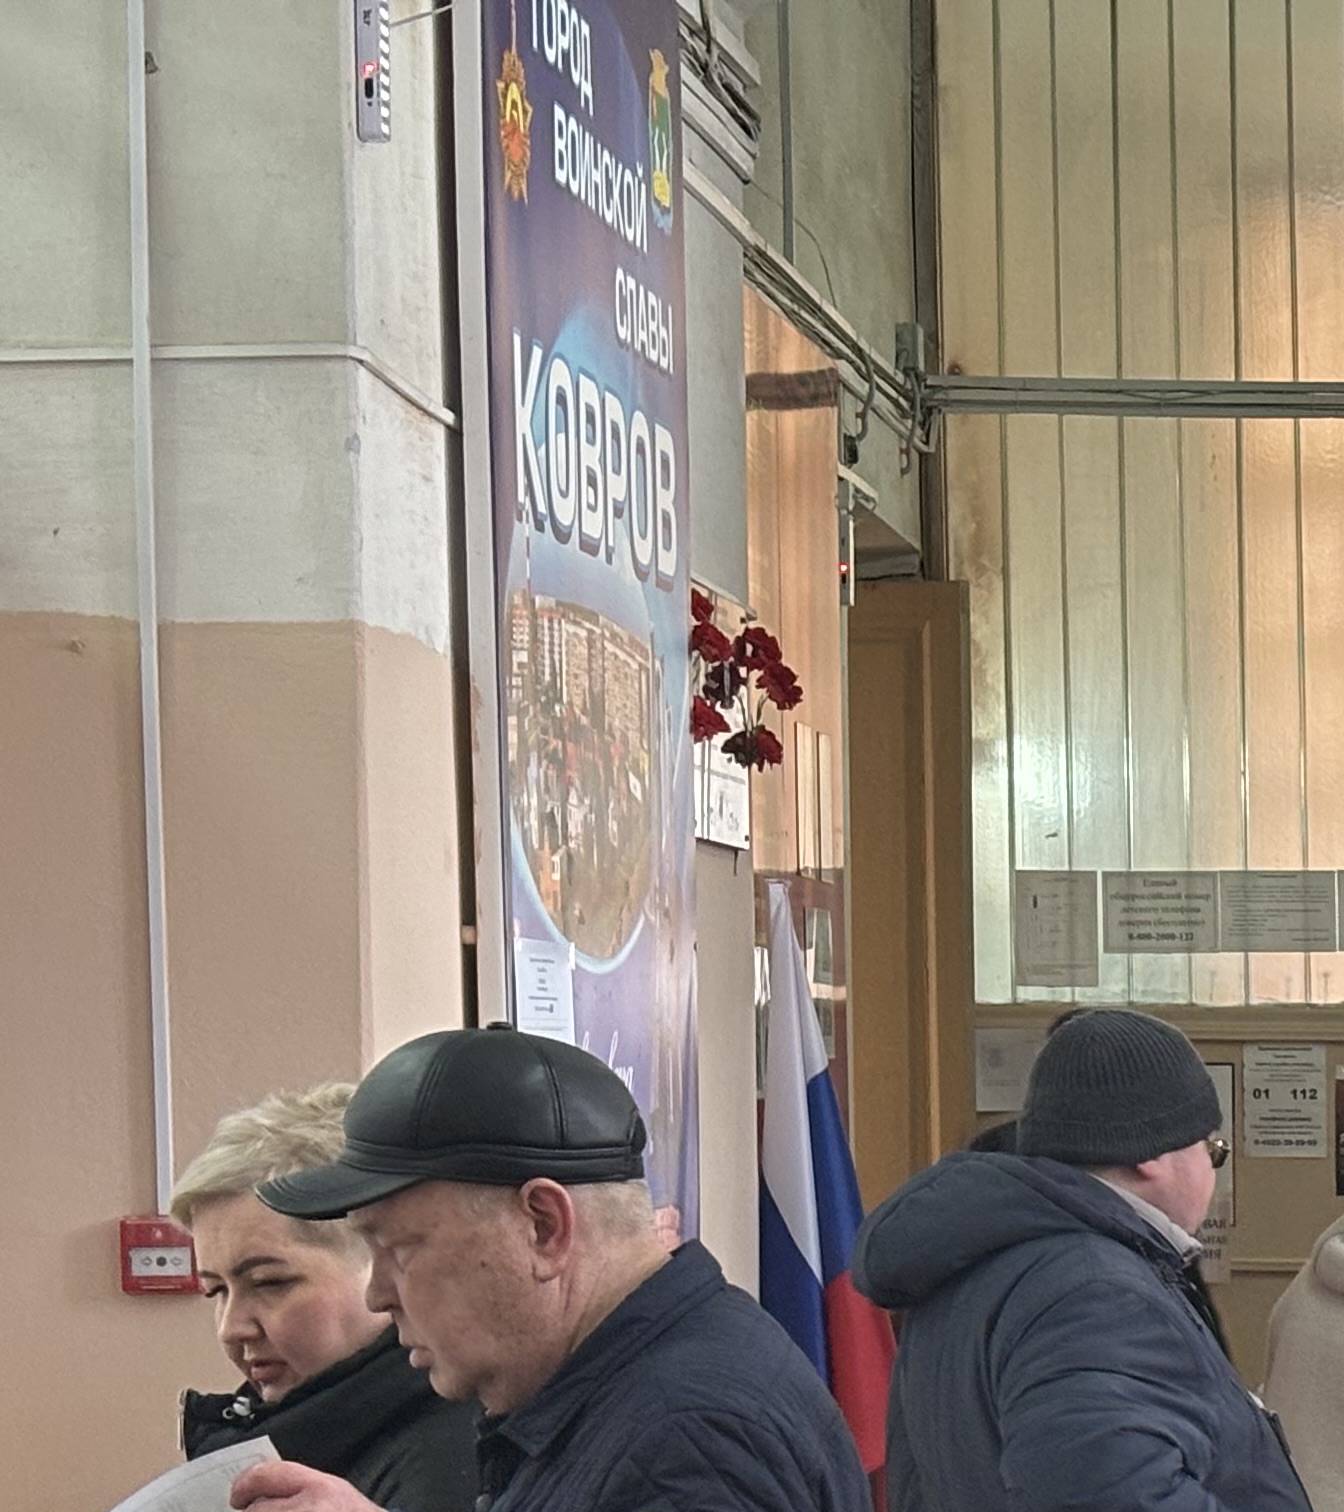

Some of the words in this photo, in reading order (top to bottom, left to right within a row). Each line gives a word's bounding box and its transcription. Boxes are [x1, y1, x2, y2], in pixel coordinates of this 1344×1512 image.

[553, 101, 648, 253] ВОИНСКОЙ
[614, 266, 674, 374] СЛАВЫ
[512, 328, 678, 592] КОВРОВ
[1252, 1088, 1270, 1100] 01
[1290, 1088, 1318, 1100] 112
